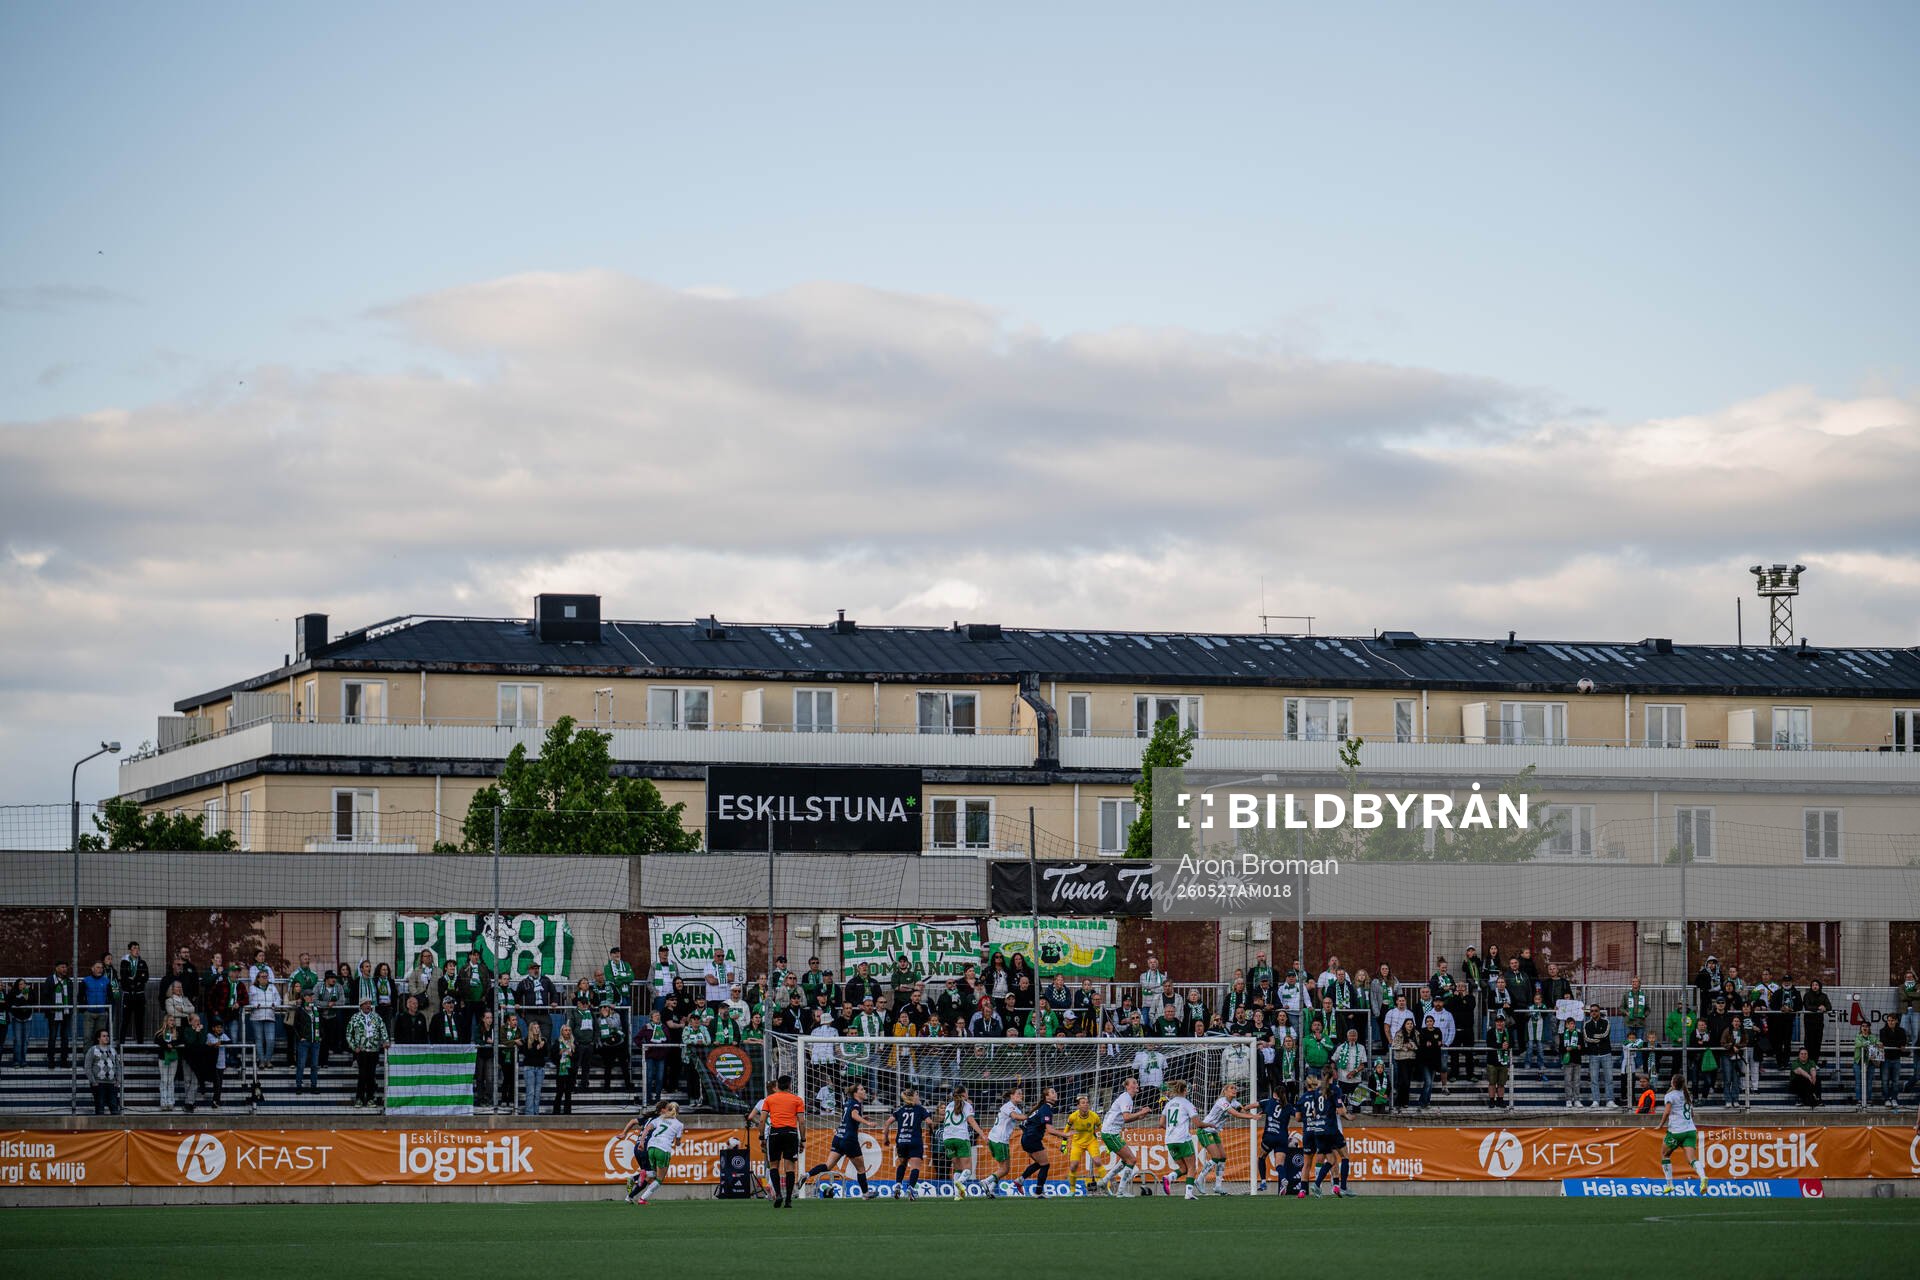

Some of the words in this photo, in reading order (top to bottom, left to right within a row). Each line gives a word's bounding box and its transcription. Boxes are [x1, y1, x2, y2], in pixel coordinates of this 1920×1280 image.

[718, 794, 908, 822] ESKILSTUNA
[1043, 863, 1109, 902] Tuna
[662, 932, 715, 947] BAJEN
[853, 929, 974, 953] BAJEN
[680, 947, 736, 962] SAMA
[852, 961, 978, 977] OMANIE
[1273, 1105, 1282, 1119] 9
[1318, 1096, 1325, 1112] 8
[1683, 1103, 1691, 1120] 8
[902, 1112, 915, 1127] 21
[944, 1110, 964, 1127] 20
[1167, 1109, 1179, 1127] 14
[411, 1132, 482, 1144] Eskilstuna
[654, 1124, 669, 1138] 7
[1708, 1127, 1772, 1141] Eskilstuna
[0, 1140, 56, 1158] ilstuna
[671, 1139, 728, 1156] skilstun
[1346, 1137, 1396, 1154] ilstuna
[1698, 1131, 1819, 1177] logistik
[236, 1146, 333, 1170] KFAST
[400, 1133, 534, 1182] logistik
[1533, 1143, 1620, 1166] KFAST
[0, 1162, 24, 1183] rgi
[29, 1162, 42, 1181] &
[46, 1162, 86, 1183] Miljö
[667, 1160, 708, 1180] nergi
[1349, 1158, 1367, 1178] rgi
[1371, 1158, 1383, 1175] &
[1387, 1158, 1423, 1180] Miljö
[1582, 1180, 1628, 1197] Heja
[1702, 1181, 1771, 1197] otboll!
